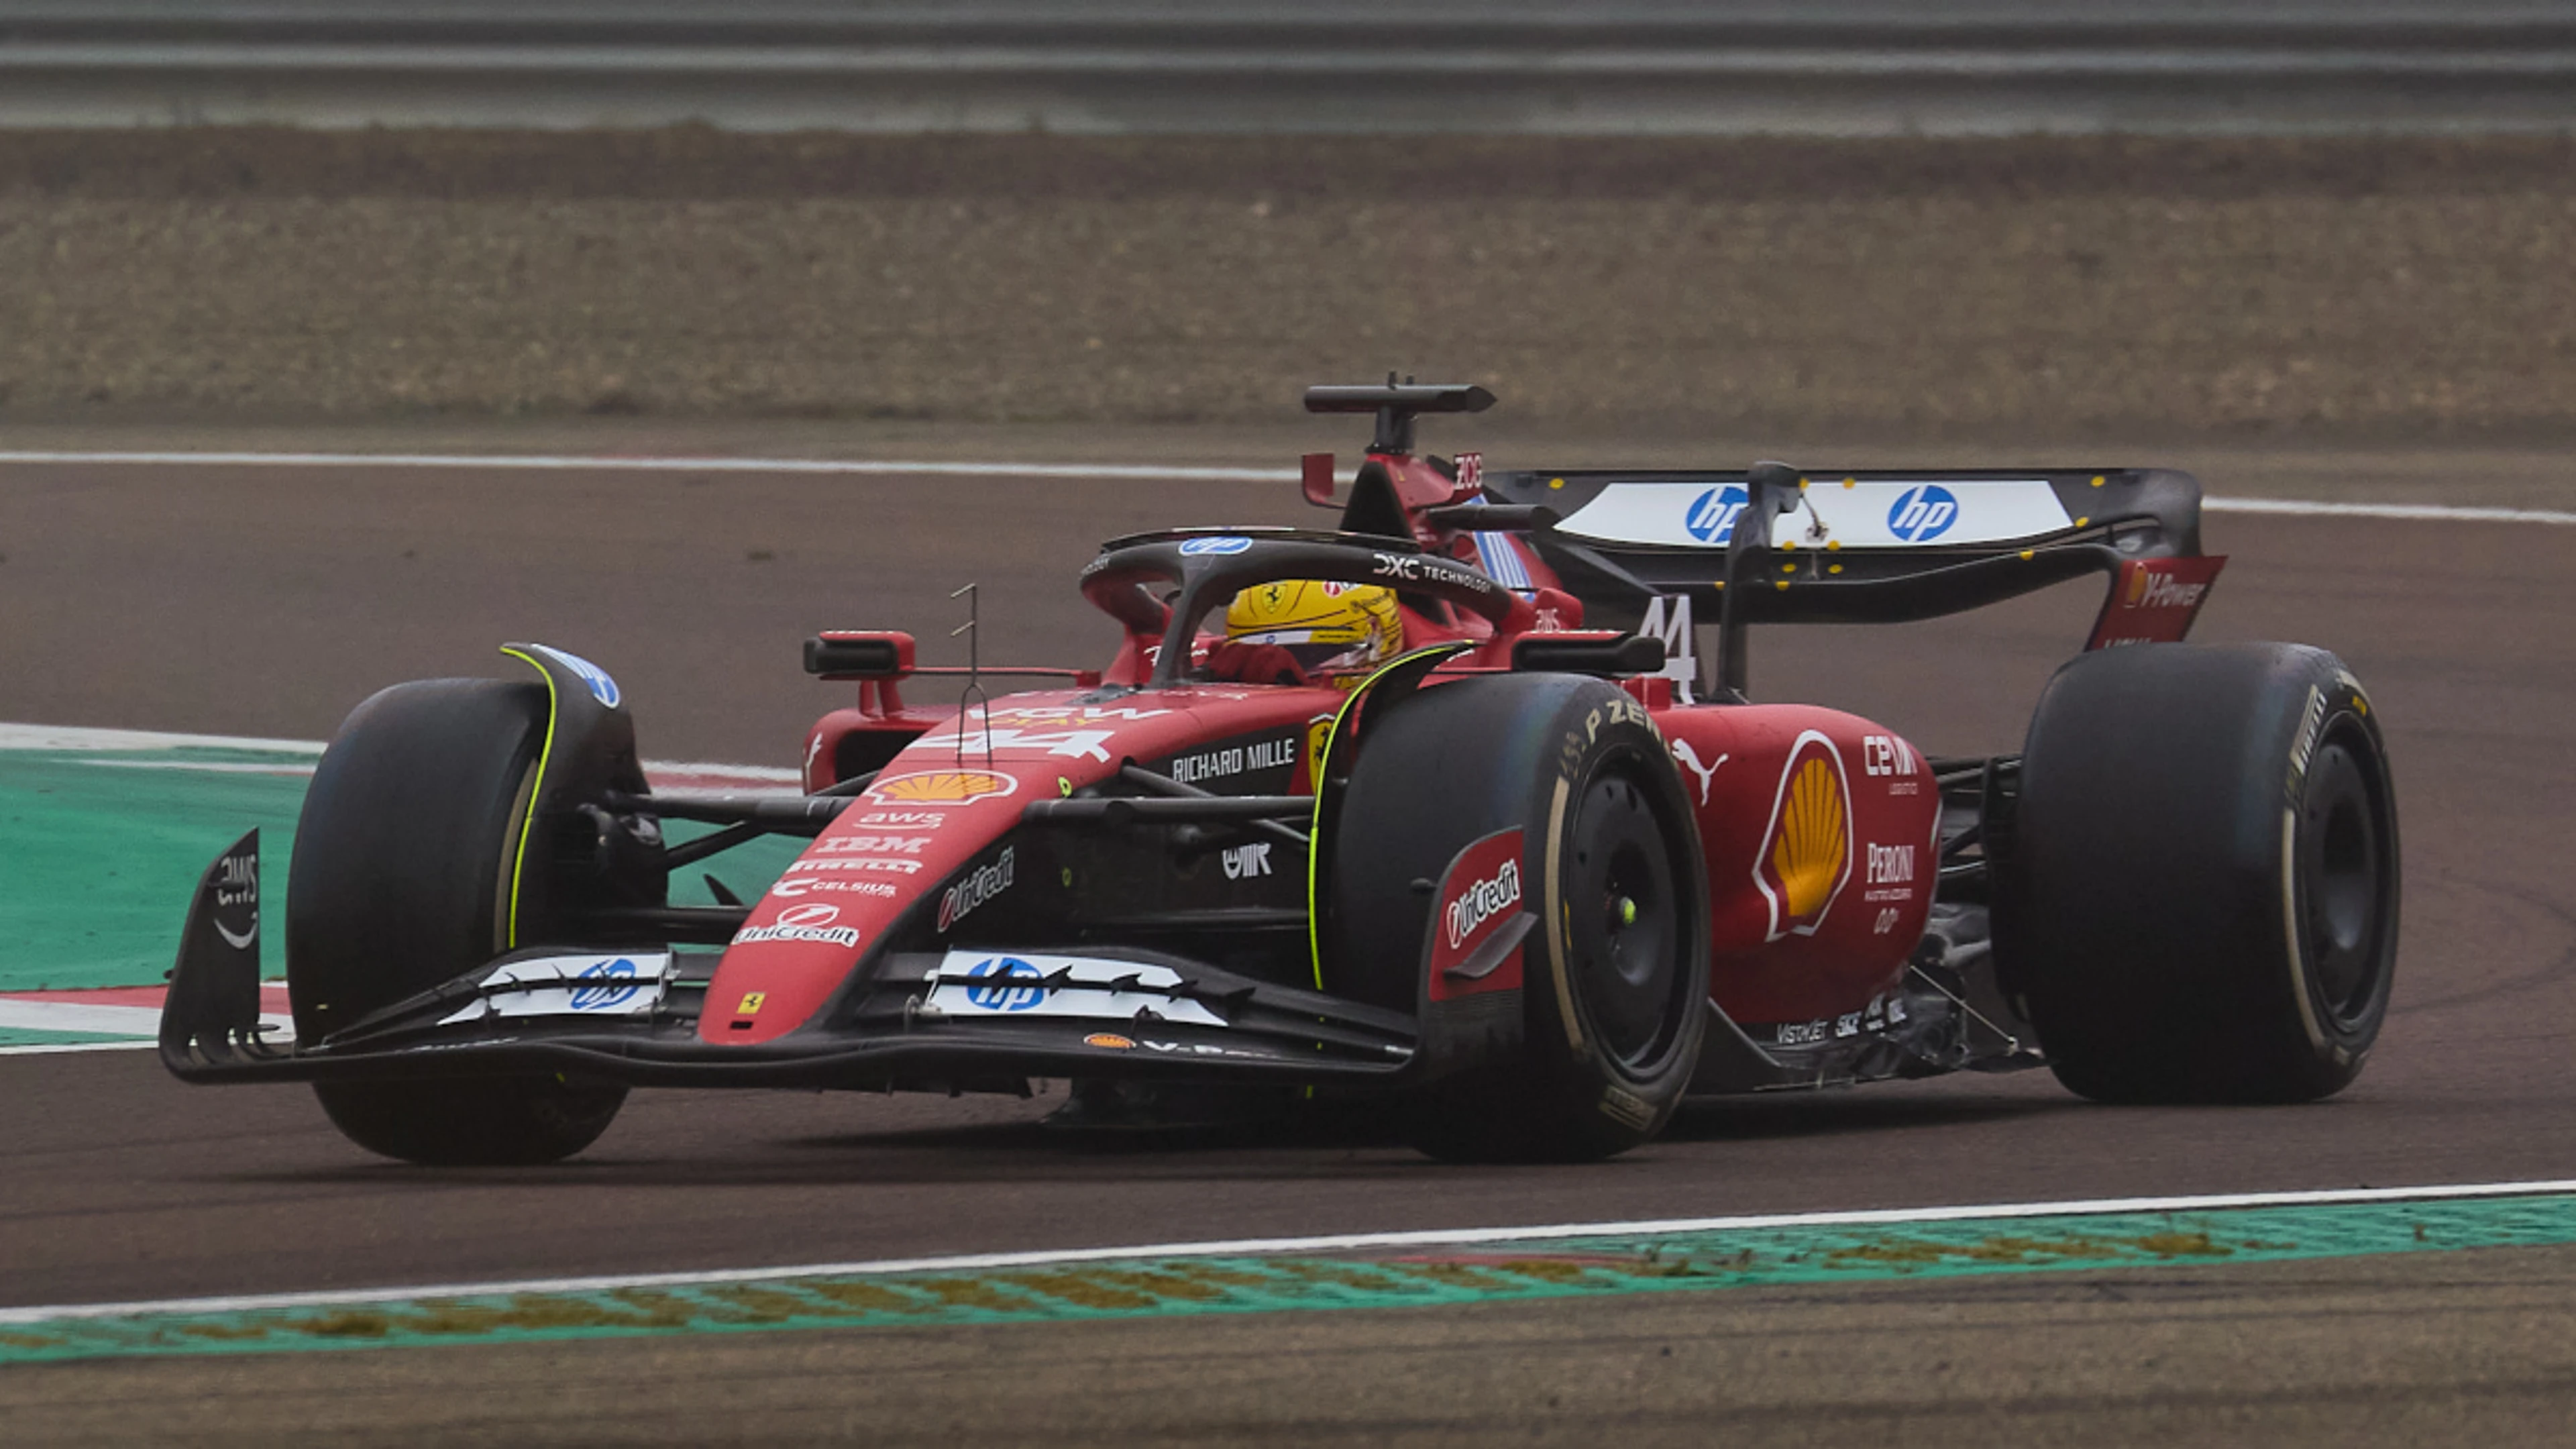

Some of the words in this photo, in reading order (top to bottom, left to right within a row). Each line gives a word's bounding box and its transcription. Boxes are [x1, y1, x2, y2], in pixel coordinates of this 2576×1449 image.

[1887, 485, 1958, 542] hp
[1373, 553, 1419, 580] DXC
[1424, 566, 1491, 593] TECHNOLOGY
[1633, 594, 1697, 705] 44
[967, 708, 1173, 720] VGW
[1586, 708, 1601, 745] P
[904, 729, 1116, 763] 44
[1173, 748, 1242, 784] RICHARD
[1246, 738, 1295, 770] MILLE
[857, 812, 945, 827] aws
[815, 837, 932, 853] IBM
[1866, 843, 1915, 883] PERONI
[785, 857, 924, 874] PIRELLI
[811, 881, 896, 894] CELSIUS
[1459, 859, 1520, 937] UniCredit
[968, 957, 1044, 1012] hp
